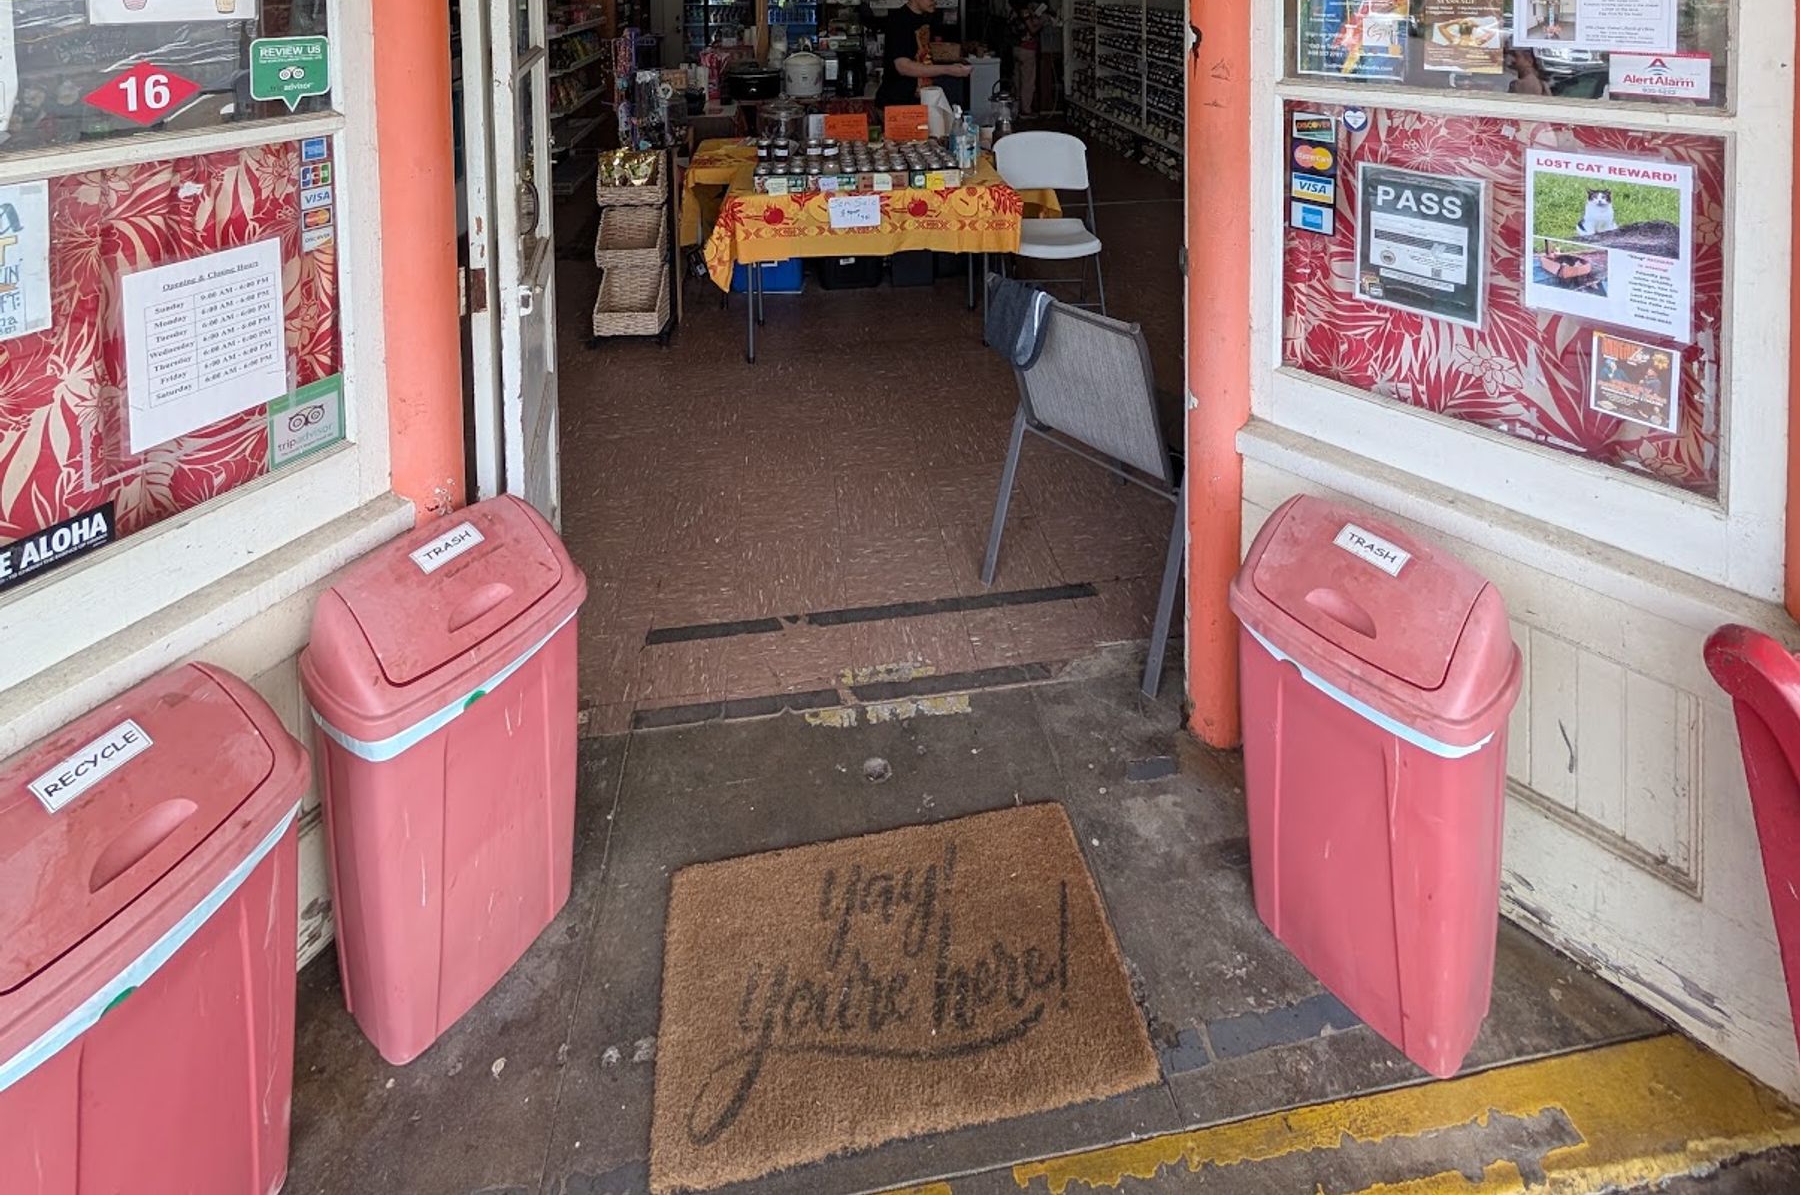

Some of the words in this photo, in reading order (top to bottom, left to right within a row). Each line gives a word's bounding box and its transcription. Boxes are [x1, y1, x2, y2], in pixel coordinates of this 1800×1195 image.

[260, 46, 303, 57] REVIEW
[307, 45, 321, 54] US
[119, 75, 170, 111] 16
[1299, 181, 1327, 194] VISA
[1536, 158, 1571, 169] LOST
[1576, 163, 1604, 173] CAT
[1608, 166, 1677, 182] REWARD!
[305, 191, 330, 204] VISA
[1376, 185, 1462, 219] PASS
[154, 302, 184, 314] Sunday
[219, 287, 233, 296] AM
[257, 277, 269, 285] PM
[162, 279, 199, 292] Opening
[207, 267, 235, 279] Closing
[154, 315, 187, 329] Monday
[221, 300, 234, 309] AM
[257, 290, 270, 298] PM
[156, 329, 187, 343] Tuesday
[222, 313, 234, 323] AM
[258, 303, 270, 312] PM
[150, 340, 195, 359] Wednesday
[222, 326, 235, 336] AM
[258, 316, 271, 325] PM
[154, 355, 192, 372] Thursday
[222, 340, 236, 350] AM
[258, 328, 272, 338] PM
[155, 383, 193, 400] Saturday
[223, 366, 237, 376] AM
[260, 354, 273, 363] PM
[160, 371, 187, 385] Friday
[223, 354, 236, 363] AM
[260, 341, 272, 351] PM
[20, 512, 107, 569] ALOHA
[423, 530, 471, 560] TRASH
[1348, 532, 1397, 563] TRASH
[44, 730, 139, 797] RECYCLE
[933, 878, 1071, 1033] here!
